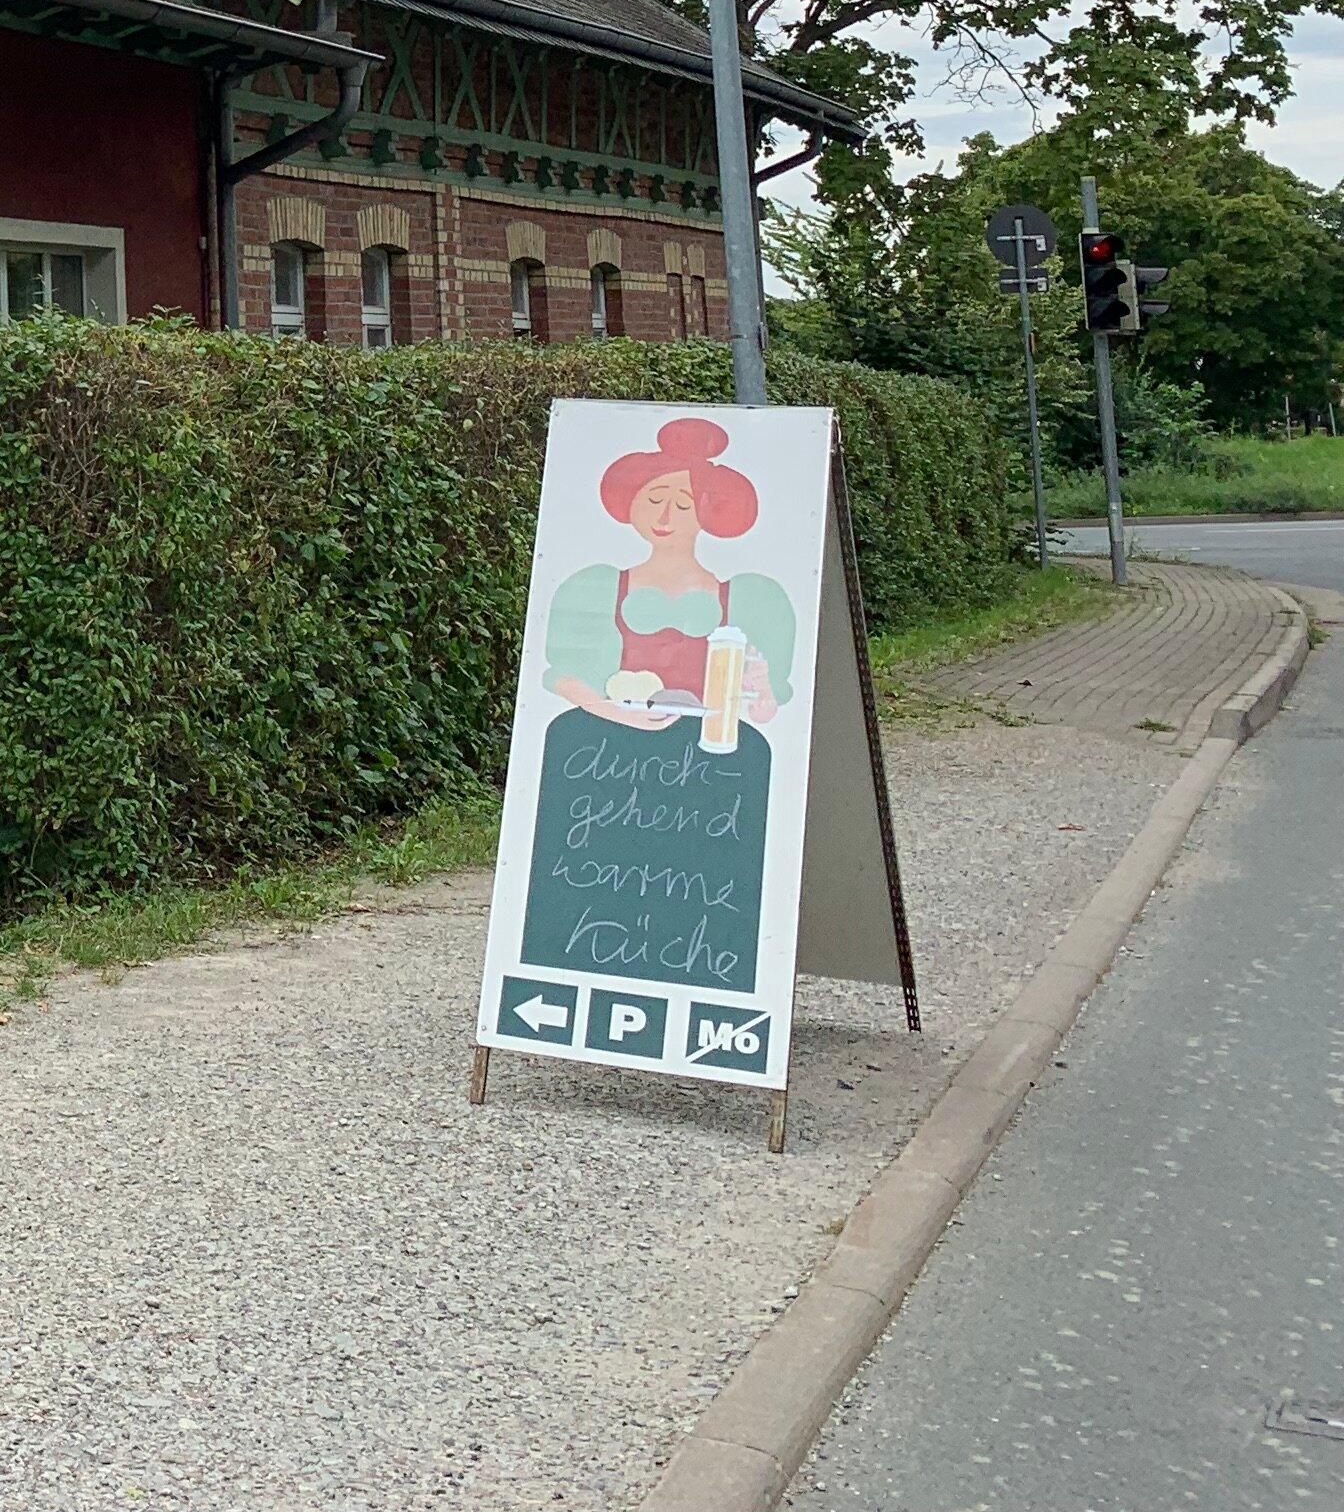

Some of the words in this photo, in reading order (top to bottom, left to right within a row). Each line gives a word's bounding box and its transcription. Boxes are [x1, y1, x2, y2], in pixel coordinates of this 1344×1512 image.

[563, 737, 741, 786] durch-
[566, 786, 741, 849] gehend
[566, 906, 738, 983] Küche
[608, 1003, 647, 1042] P
[697, 1019, 760, 1054] Mo
